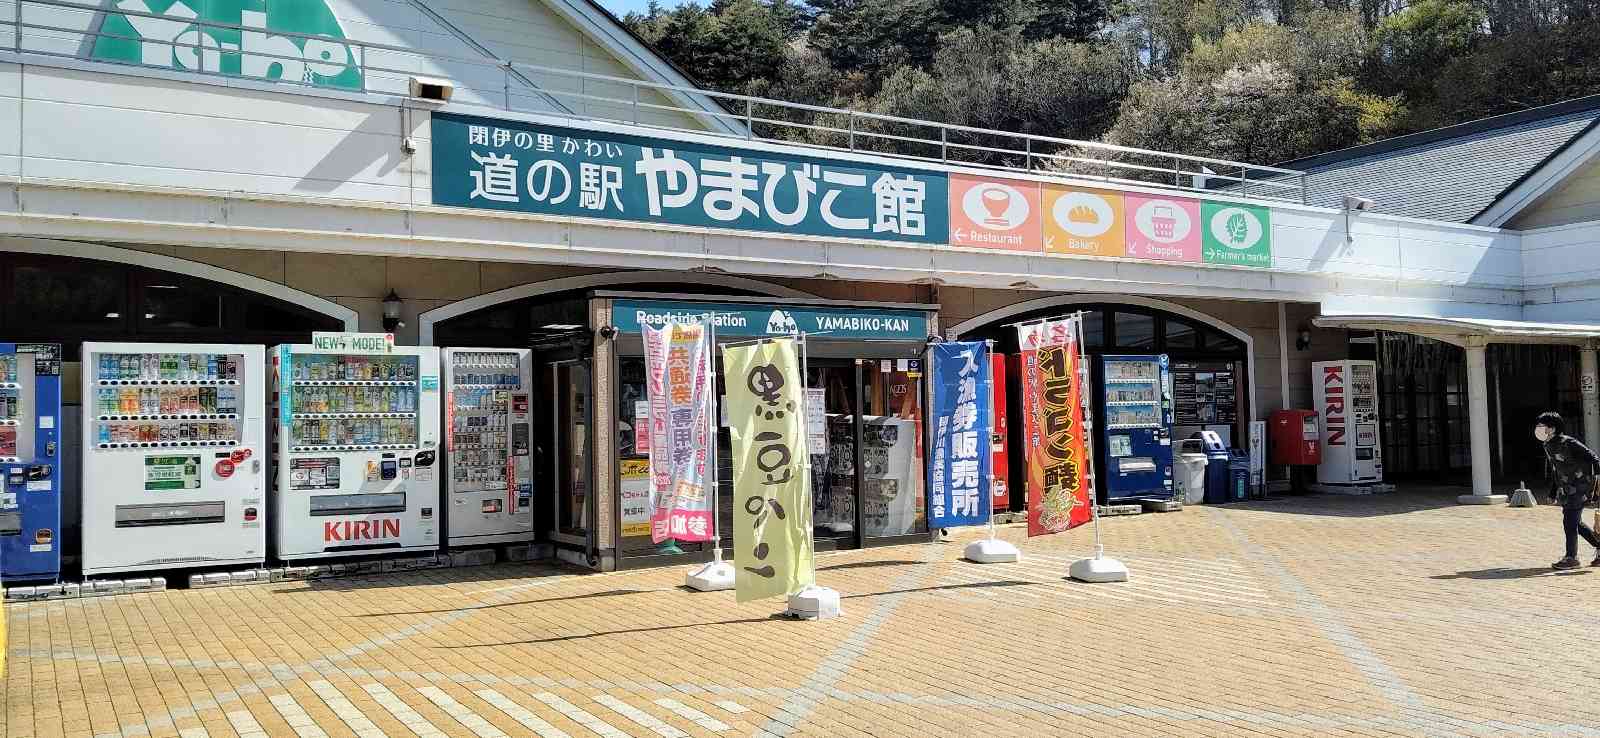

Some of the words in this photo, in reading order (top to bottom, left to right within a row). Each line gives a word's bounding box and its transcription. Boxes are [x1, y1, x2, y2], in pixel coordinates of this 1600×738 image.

[468, 125, 555, 153] 閉伊の里
[562, 138, 623, 159] かわい
[470, 150, 624, 213] 道の駅
[635, 147, 926, 237] やまびこ館
[970, 231, 1023, 246] Restaurant
[1068, 238, 1100, 253] Bakery
[1145, 242, 1184, 260] Shopping
[1247, 252, 1270, 262] market
[815, 316, 909, 332] YAMABIKO-KAN
[314, 336, 339, 349] NEW
[1323, 366, 1346, 446] KIRIN
[952, 349, 980, 518] 入漁券販売所
[324, 519, 401, 543] KIRIN
